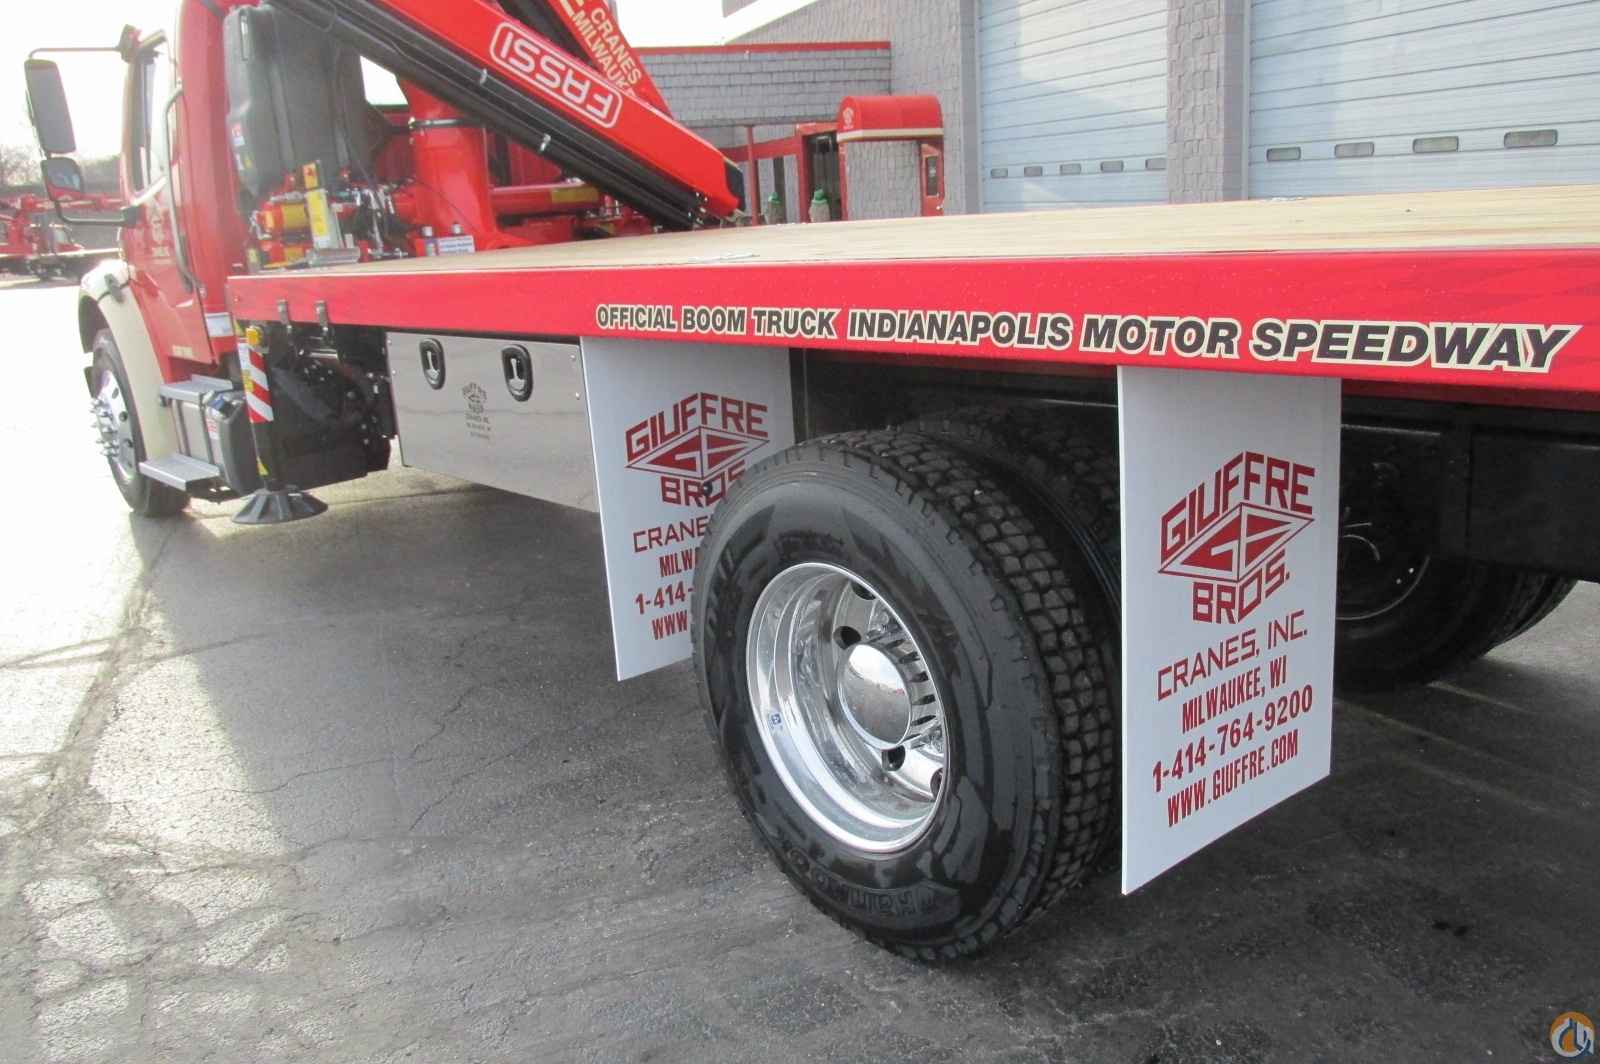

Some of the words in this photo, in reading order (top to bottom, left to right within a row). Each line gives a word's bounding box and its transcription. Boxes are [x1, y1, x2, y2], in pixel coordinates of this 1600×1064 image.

[500, 31, 614, 119] FASSI
[591, 7, 642, 85] CRANES
[597, 303, 678, 332] OFFICIAL
[682, 306, 747, 335] BOOM
[752, 307, 841, 340] TRUCK
[847, 309, 1074, 350] INDIANAPOLIS
[1079, 314, 1240, 360] MOTOR
[1249, 317, 1583, 373] SPEEDWAY
[625, 392, 768, 462] GIUFFRE
[633, 515, 708, 553] CRANE
[1161, 451, 1315, 566] GIUFFRE
[635, 580, 694, 615] 1-414-
[651, 609, 688, 641] WWW
[1192, 549, 1290, 625] BROS.
[1157, 628, 1260, 701] CRANES,
[1267, 609, 1308, 650] INC.
[1182, 666, 1265, 735] MILWAUKEE,
[1270, 655, 1287, 690] WI
[1152, 684, 1313, 793] 1-414-764-9200
[1167, 728, 1299, 829] WWW.GIUFFRE.COM
